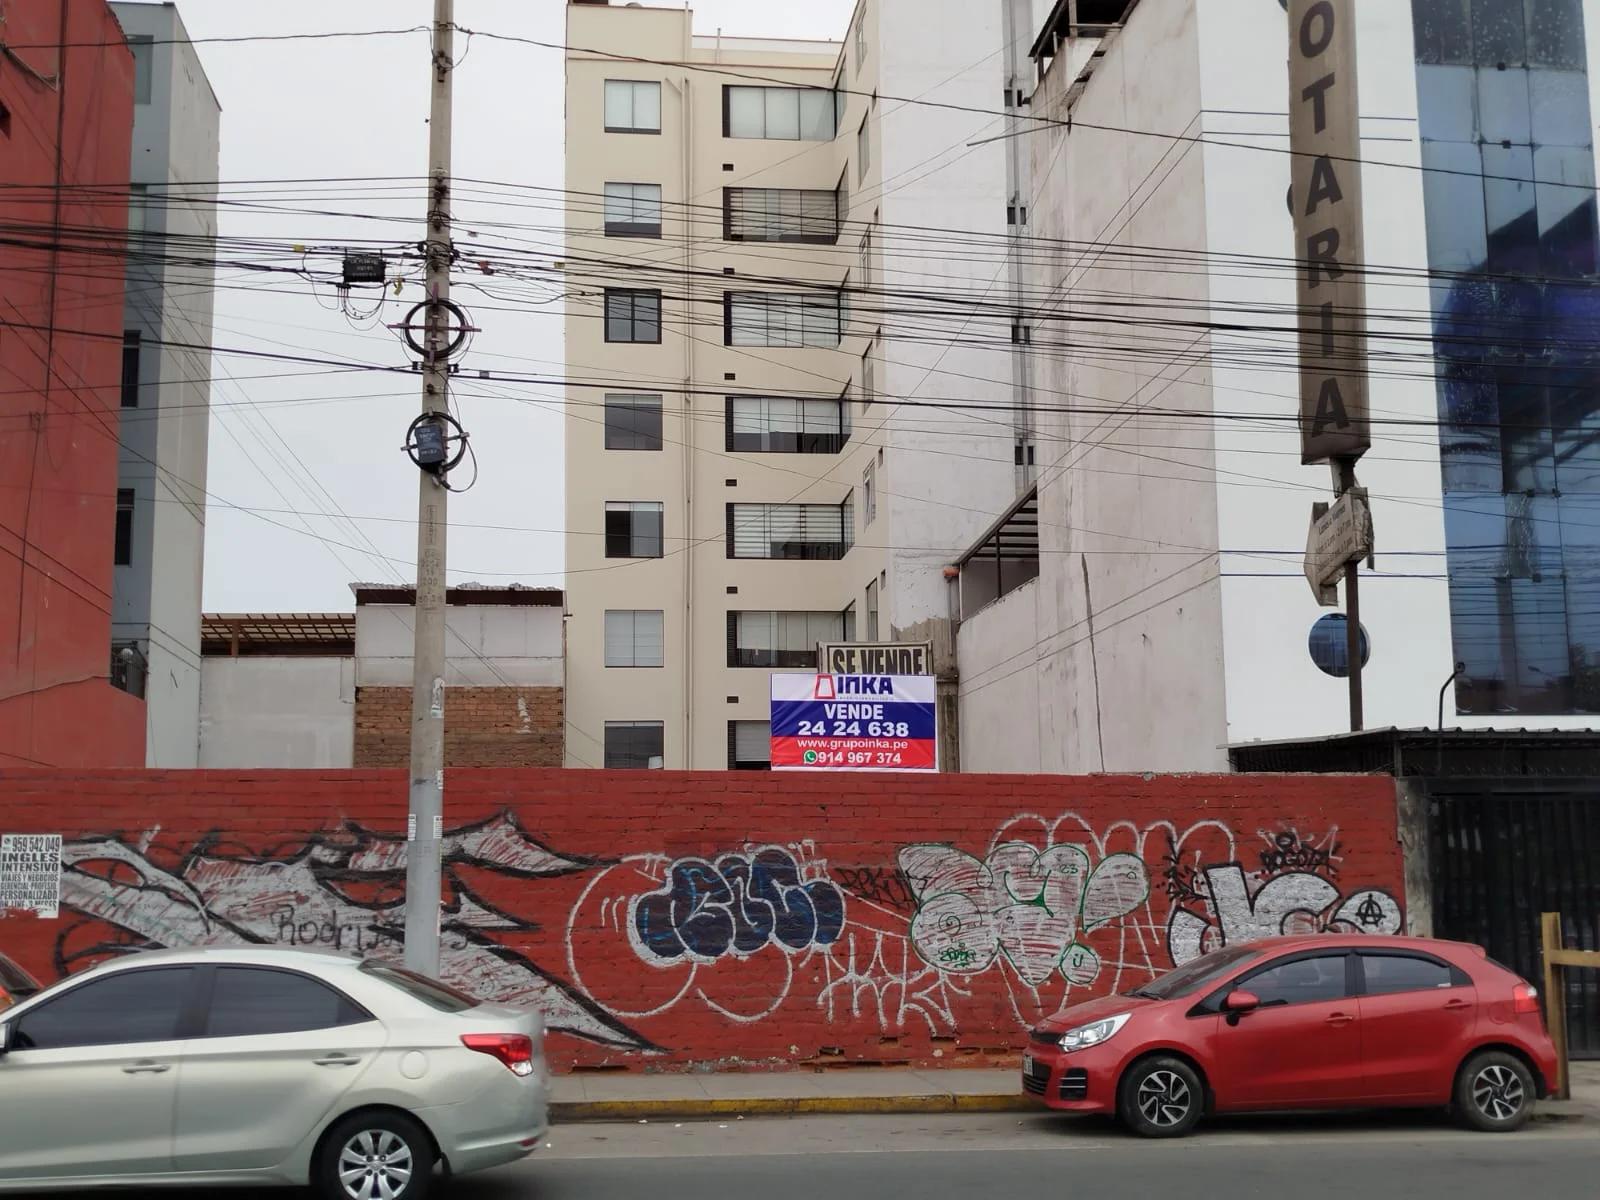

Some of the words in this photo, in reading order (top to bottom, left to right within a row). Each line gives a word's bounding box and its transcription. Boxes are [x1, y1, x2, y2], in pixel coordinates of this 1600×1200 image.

[833, 648, 856, 674] SE
[860, 648, 923, 675] VENDE
[824, 703, 884, 720] VENDE
[798, 720, 826, 736] 24
[833, 721, 861, 737] 24
[867, 722, 909, 737] 638
[797, 739, 908, 751] www.grupoinka.pe
[818, 752, 843, 764] 914
[847, 752, 872, 764] 967
[876, 752, 902, 764] 374
[29, 836, 44, 852] 542
[45, 836, 60, 852] 049
[2, 852, 59, 862] INGLES
[2, 862, 58, 872] INTENSIVO
